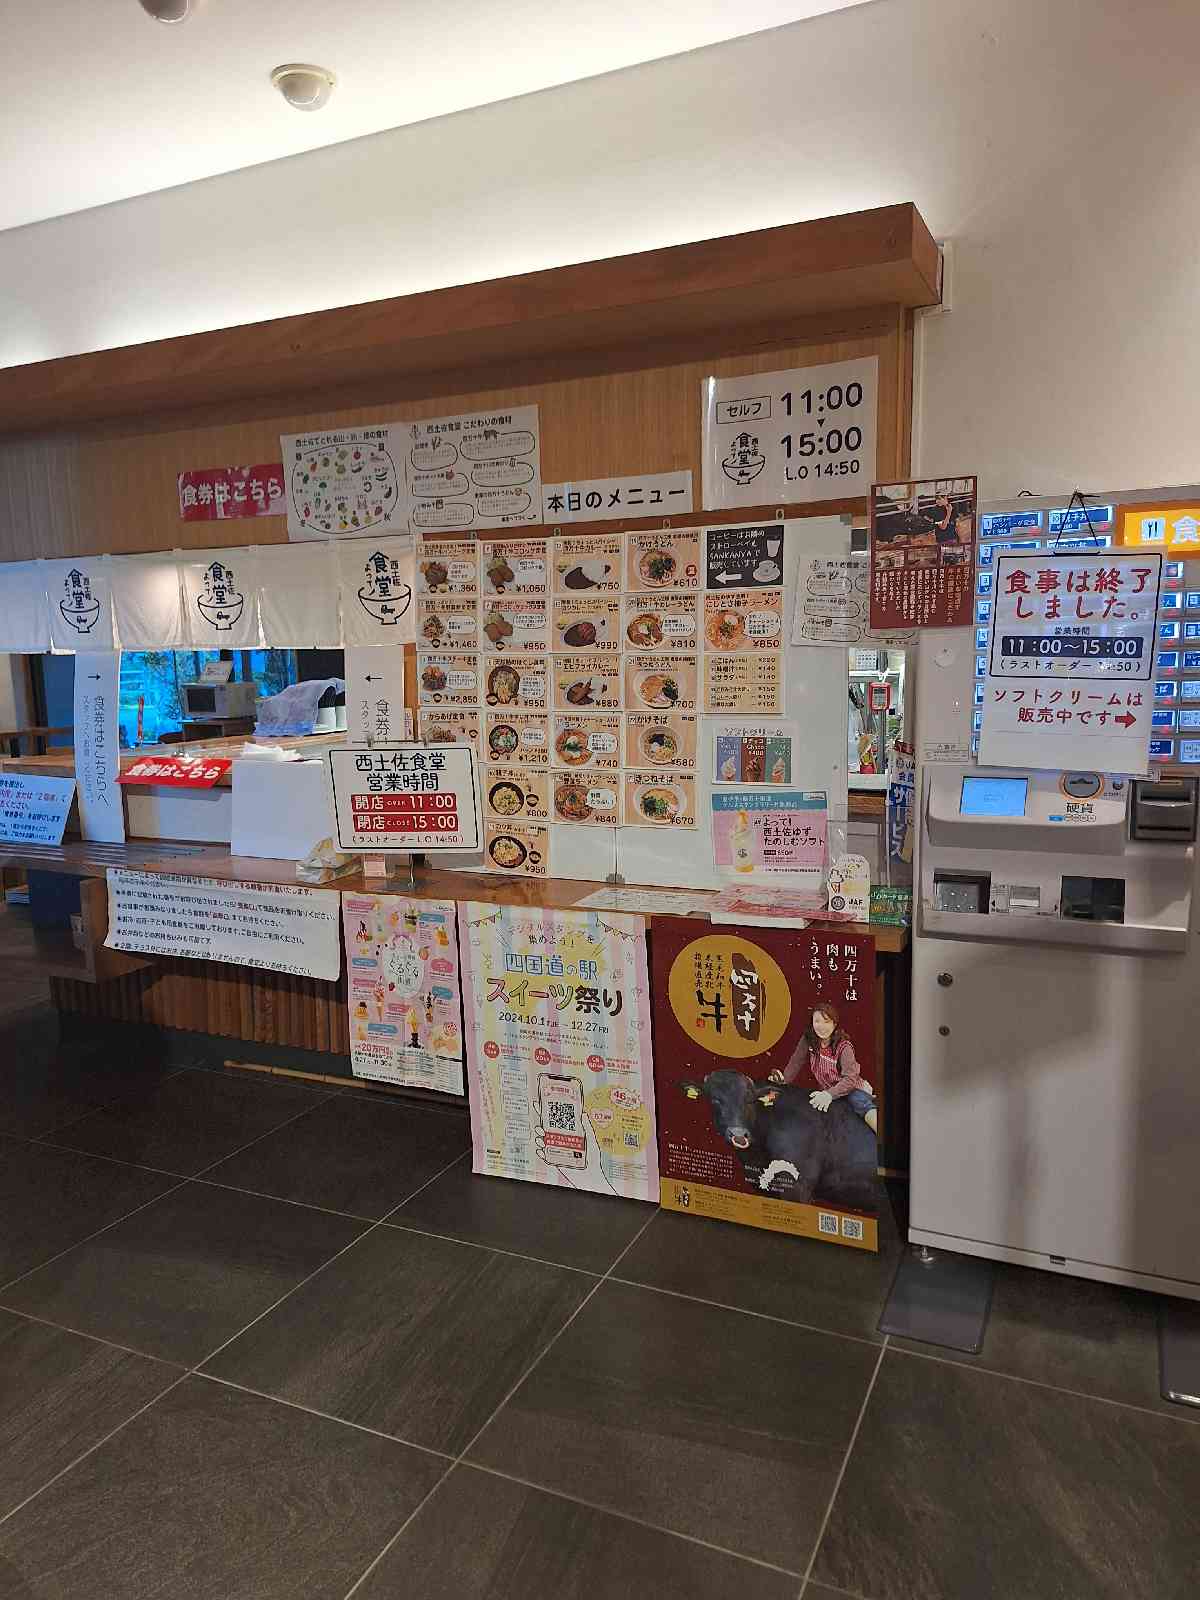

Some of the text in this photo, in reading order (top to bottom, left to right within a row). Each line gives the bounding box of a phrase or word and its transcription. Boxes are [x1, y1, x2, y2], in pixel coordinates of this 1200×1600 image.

[780, 382, 863, 416] 11:00
[726, 402, 762, 417] セルフ
[736, 432, 753, 465] 食堂
[781, 426, 862, 458] 15:00
[785, 459, 860, 481] L.O 14:50
[182, 477, 283, 507] 食券はこちら
[547, 488, 685, 514] 本日のメニュー
[208, 561, 227, 605] 食堂
[368, 551, 392, 597] 食堂
[1004, 567, 1152, 594] 食事は終了
[67, 568, 85, 609] 食堂
[1016, 595, 1140, 621] しました。
[1054, 626, 1090, 636] 営業時間
[595, 641, 618, 650] ¥990
[753, 640, 780, 649] ¥850
[523, 699, 545, 708] ¥950
[671, 700, 694, 709] ¥700
[994, 688, 1143, 706] ソフトクリームは
[637, 715, 668, 725] かけそば
[1017, 707, 1111, 725] 販売中です
[125, 763, 222, 779] 食券はこちら
[354, 752, 448, 772] 西土佐食堂
[596, 759, 618, 769] ¥740
[672, 758, 695, 768] ¥580
[367, 773, 439, 792] 営業時間
[635, 774, 674, 784] きつねそば
[354, 795, 384, 810] 開店
[409, 794, 455, 809] 11:00
[357, 815, 385, 830] 閉店
[412, 815, 456, 830] 15:00
[671, 816, 695, 826] ¥670
[763, 827, 812, 837] 西土佐ゆず
[763, 837, 825, 847] たのしむソフト
[525, 864, 547, 876] ¥950
[848, 898, 864, 907] JAF
[809, 941, 823, 990] うまい。
[826, 943, 839, 972] 肉も
[505, 952, 599, 982] 四国道の駅
[844, 943, 858, 1002] 四万十は
[486, 977, 624, 1017] スイーツ祭り
[695, 989, 728, 1035] 牛
[498, 1010, 545, 1027] 2024.10.1
[571, 1020, 599, 1034] 12.27
